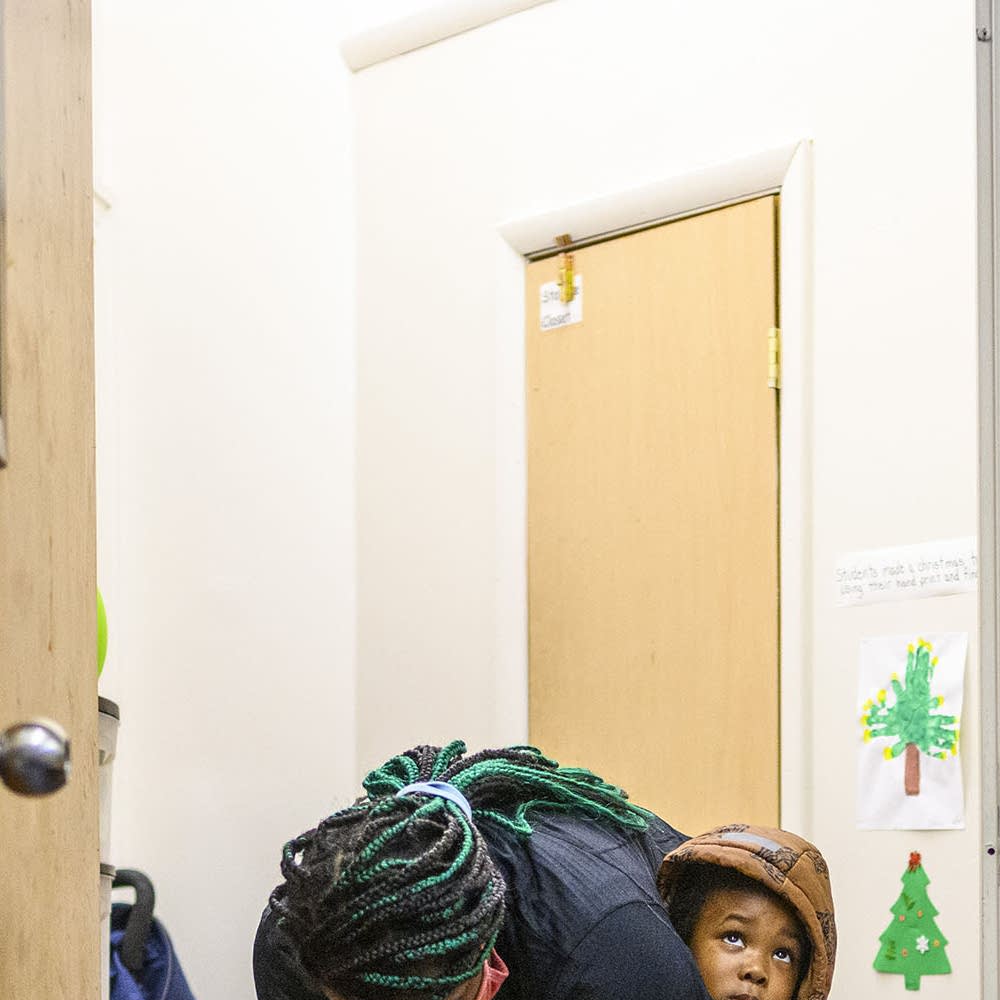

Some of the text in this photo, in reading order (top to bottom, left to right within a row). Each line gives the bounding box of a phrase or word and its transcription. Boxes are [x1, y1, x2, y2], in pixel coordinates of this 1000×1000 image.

[835, 564, 879, 583] Students
[883, 561, 904, 576] made
[868, 577, 891, 592] their
[896, 575, 917, 589] hand
[919, 574, 940, 587] print
[944, 567, 960, 583] and
